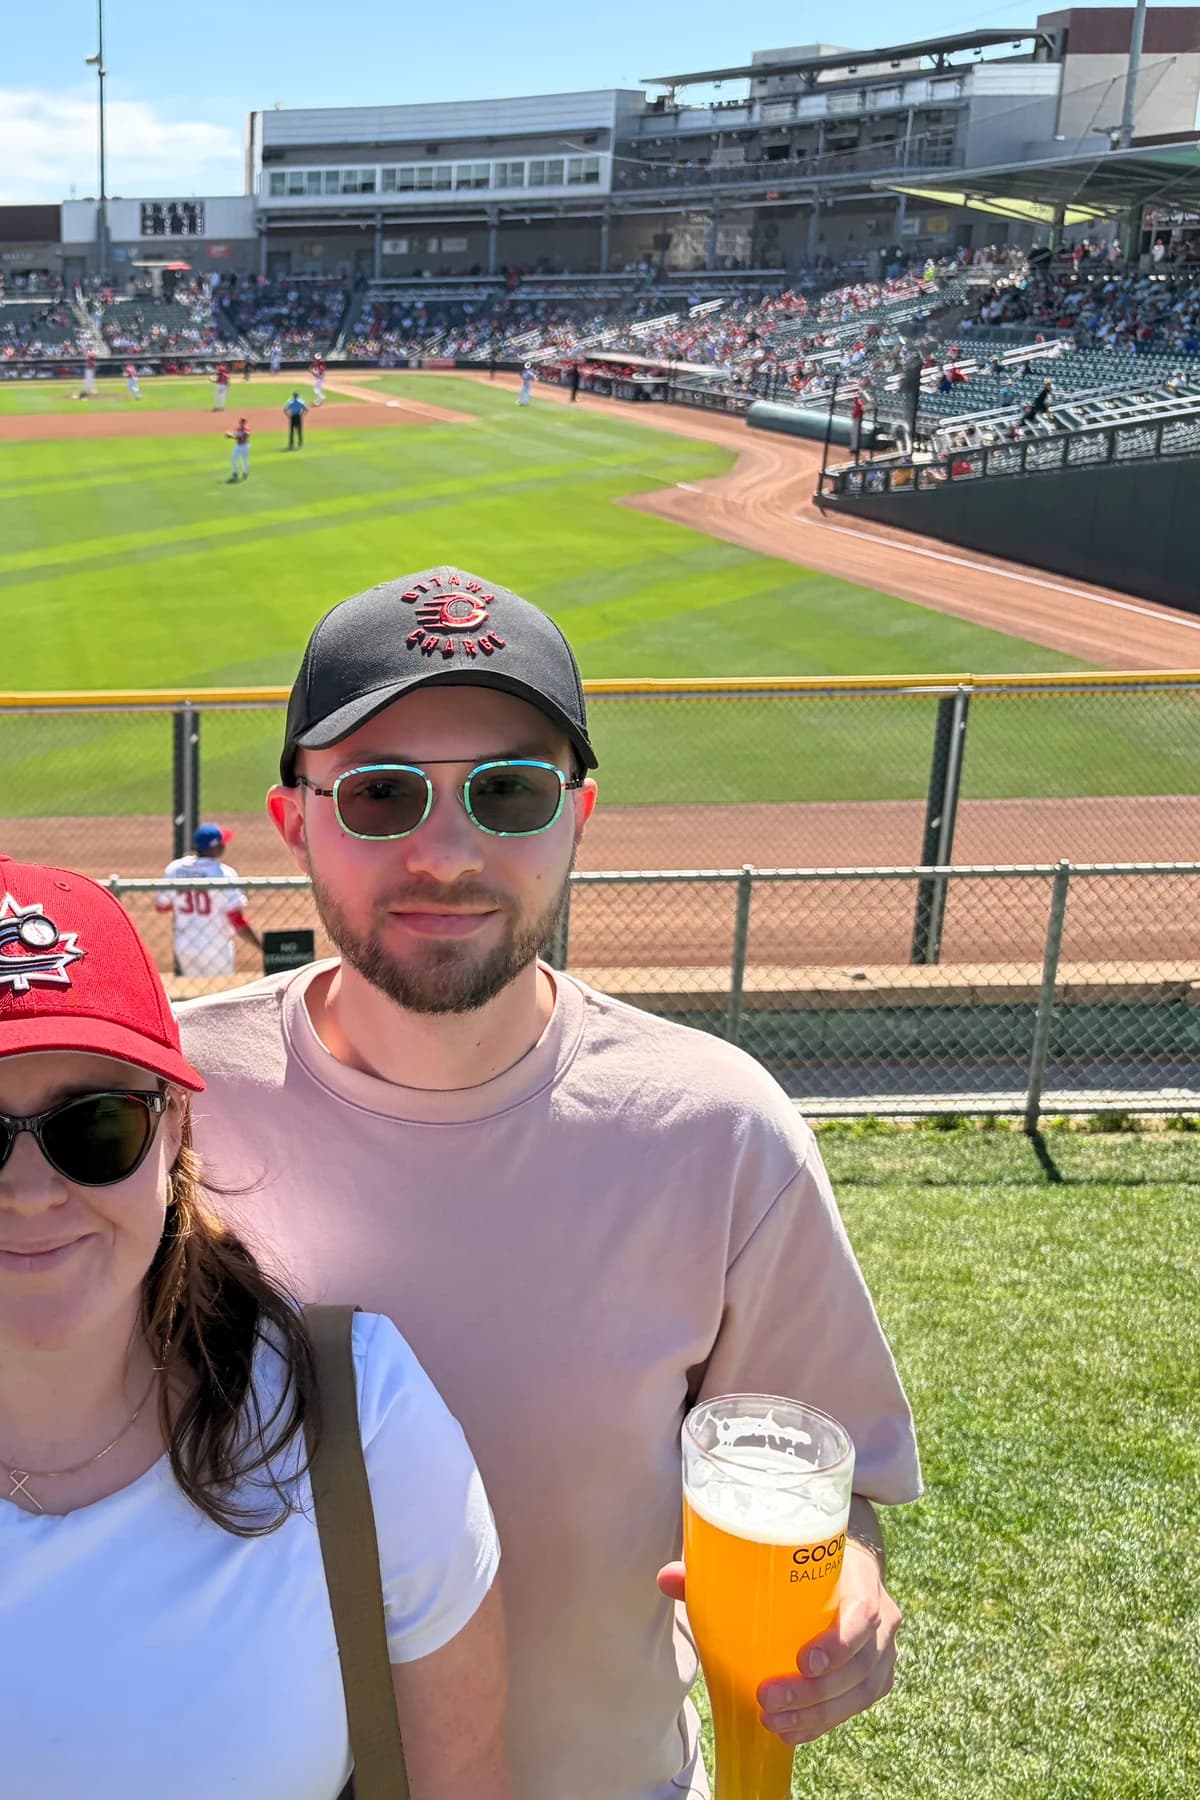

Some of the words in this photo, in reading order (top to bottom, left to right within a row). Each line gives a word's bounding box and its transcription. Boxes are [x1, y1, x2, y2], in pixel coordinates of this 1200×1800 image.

[400, 574, 497, 604] OTTAWA
[406, 627, 507, 658] CHARGE
[176, 887, 211, 916] 30
[280, 942, 298, 953] NO
